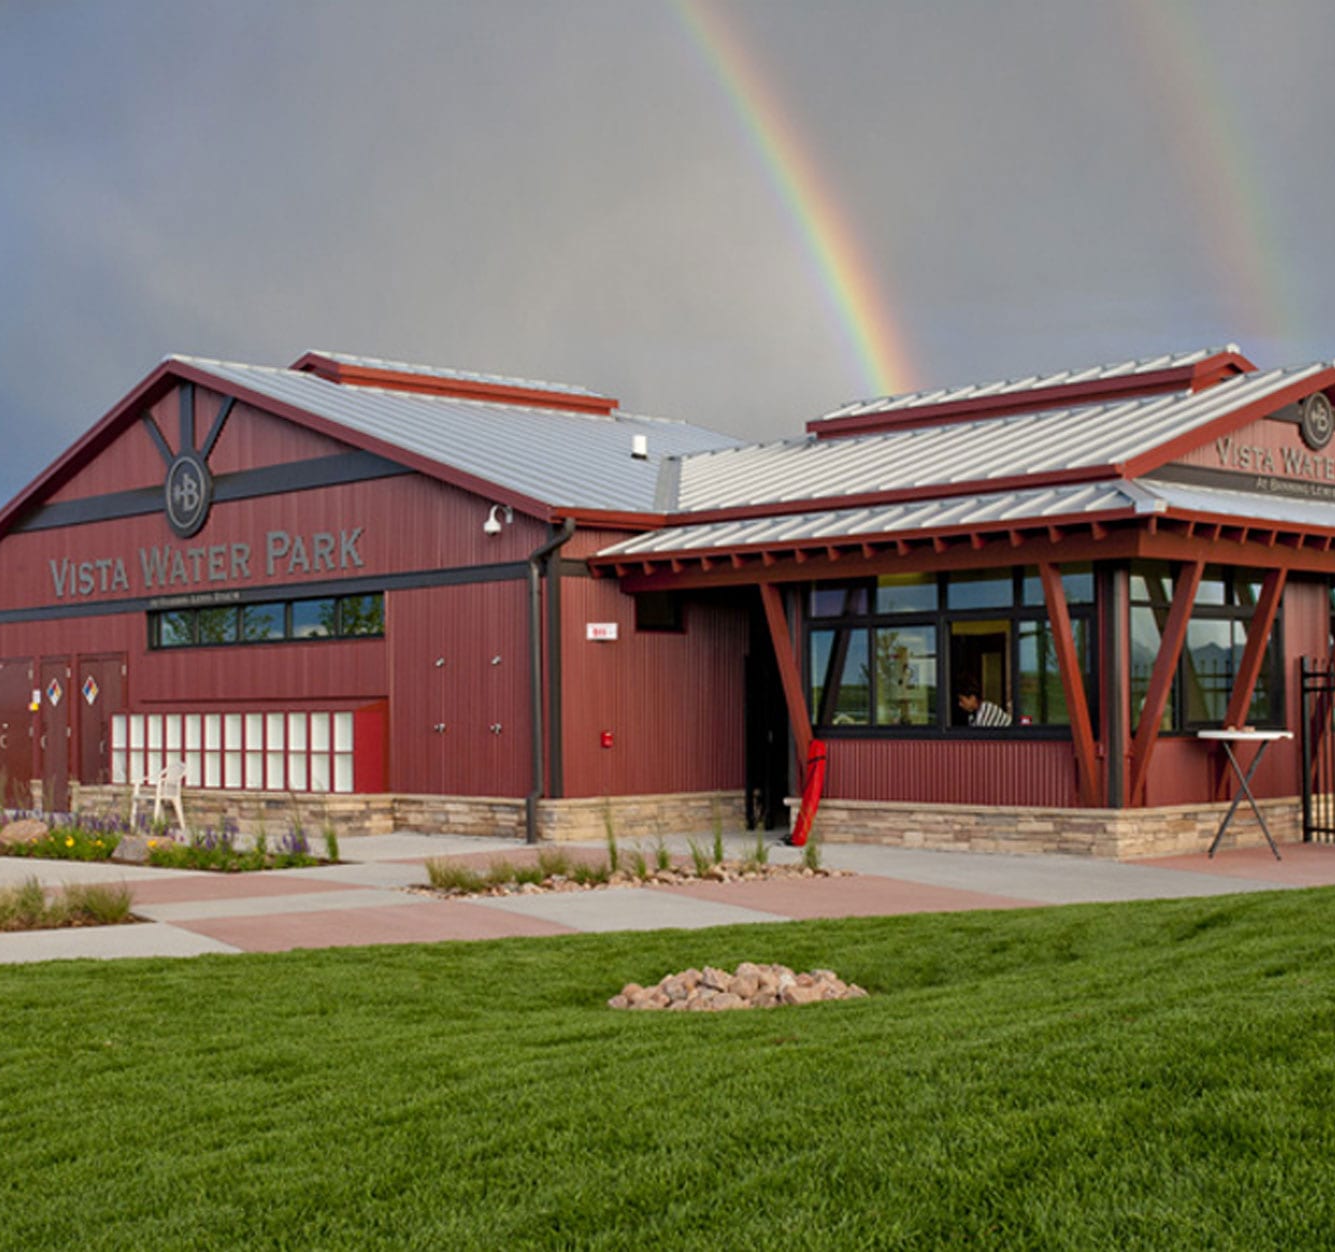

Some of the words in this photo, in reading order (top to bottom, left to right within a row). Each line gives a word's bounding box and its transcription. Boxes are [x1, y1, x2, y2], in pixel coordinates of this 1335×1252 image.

[1217, 437, 1275, 472] VISTA
[50, 556, 129, 598] VISTA
[139, 544, 252, 588] WATER
[266, 527, 365, 577] PARK
